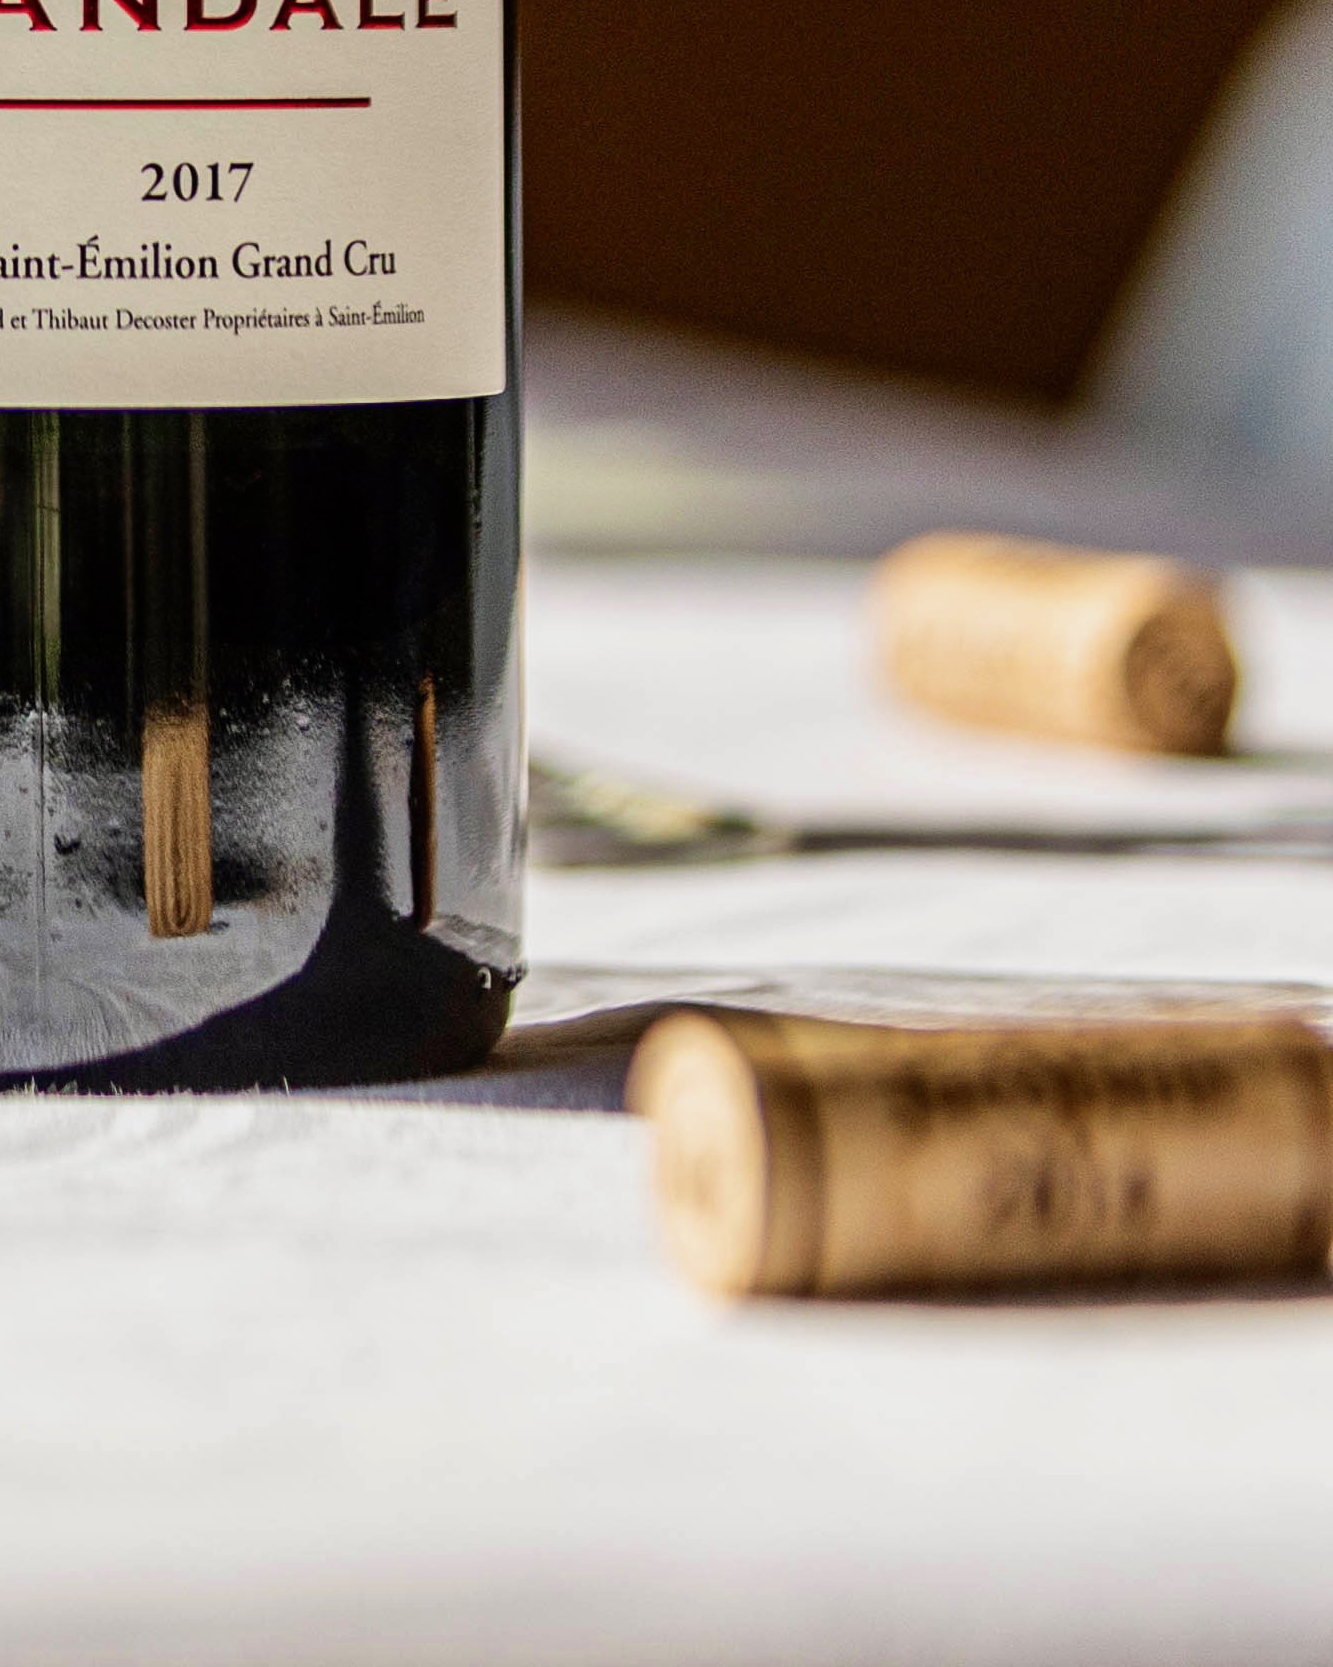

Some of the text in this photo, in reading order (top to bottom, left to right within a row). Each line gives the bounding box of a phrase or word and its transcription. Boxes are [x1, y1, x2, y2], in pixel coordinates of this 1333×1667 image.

[140, 161, 255, 204] 2017
[231, 238, 334, 280] Grand
[343, 239, 397, 277] Cru
[9, 312, 28, 331] et
[31, 307, 109, 331] Thibaut
[115, 308, 198, 331] Decoster
[202, 306, 311, 337] Propriétaires
[314, 306, 324, 328] à
[327, 300, 426, 328] Saint-Émilion
